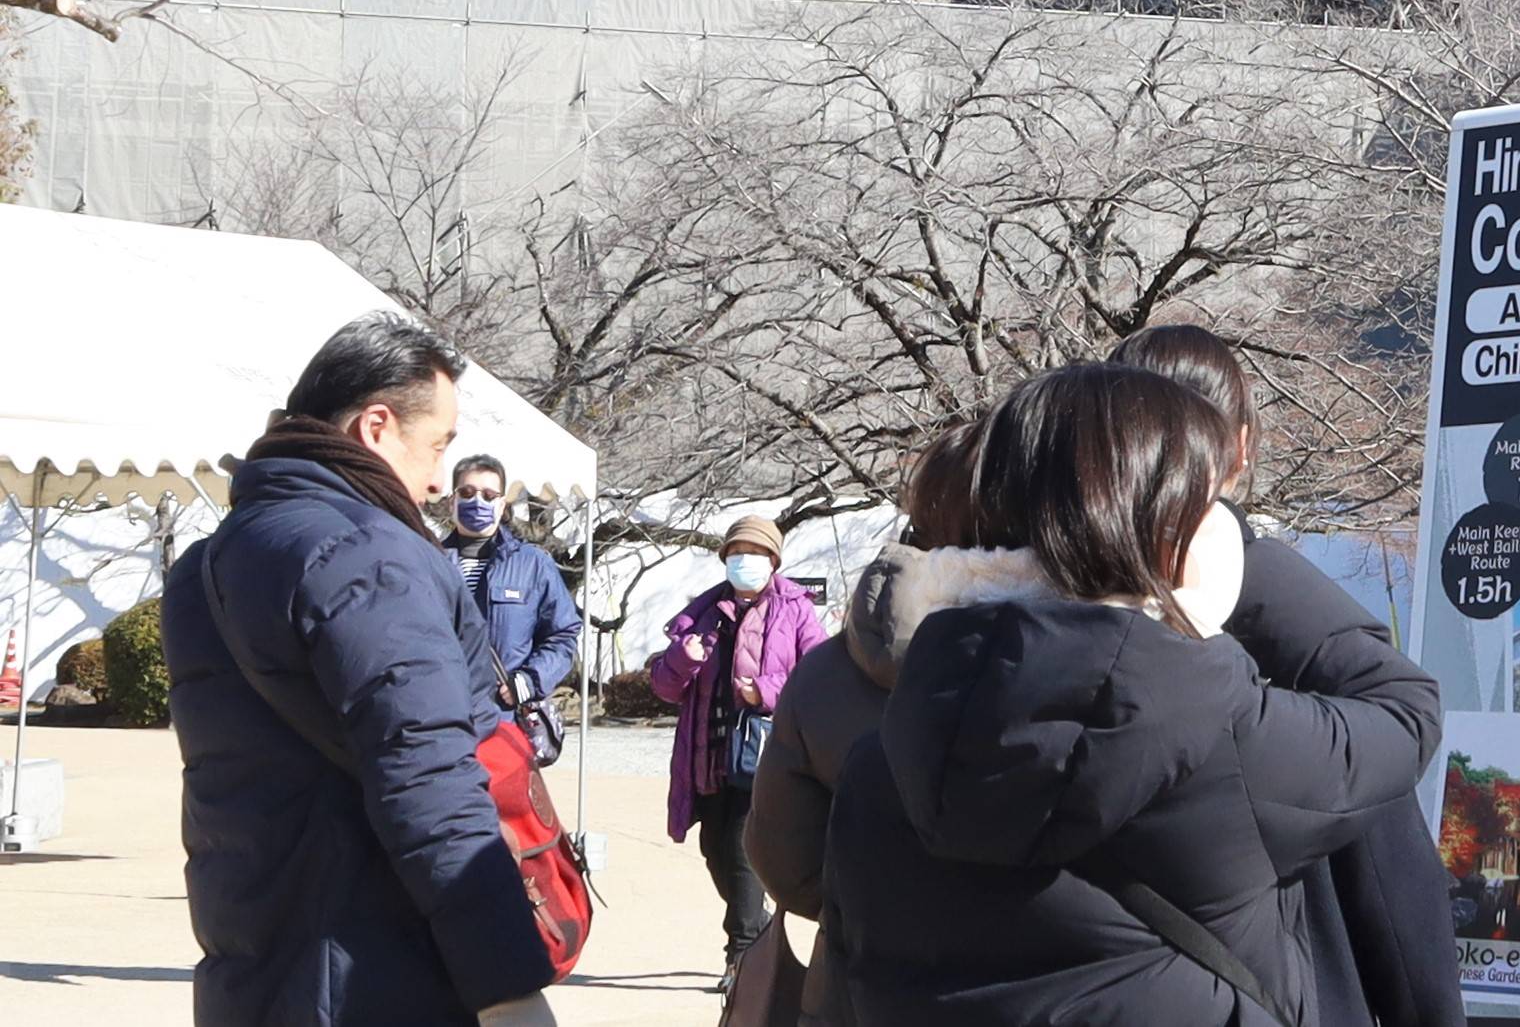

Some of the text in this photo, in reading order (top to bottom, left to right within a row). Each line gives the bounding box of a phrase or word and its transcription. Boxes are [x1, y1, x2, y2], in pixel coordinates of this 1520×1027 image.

[1457, 525, 1490, 542] Main
[1449, 540, 1489, 556] +West
[1470, 555, 1511, 571] Route
[1457, 575, 1512, 605] 1.5h
